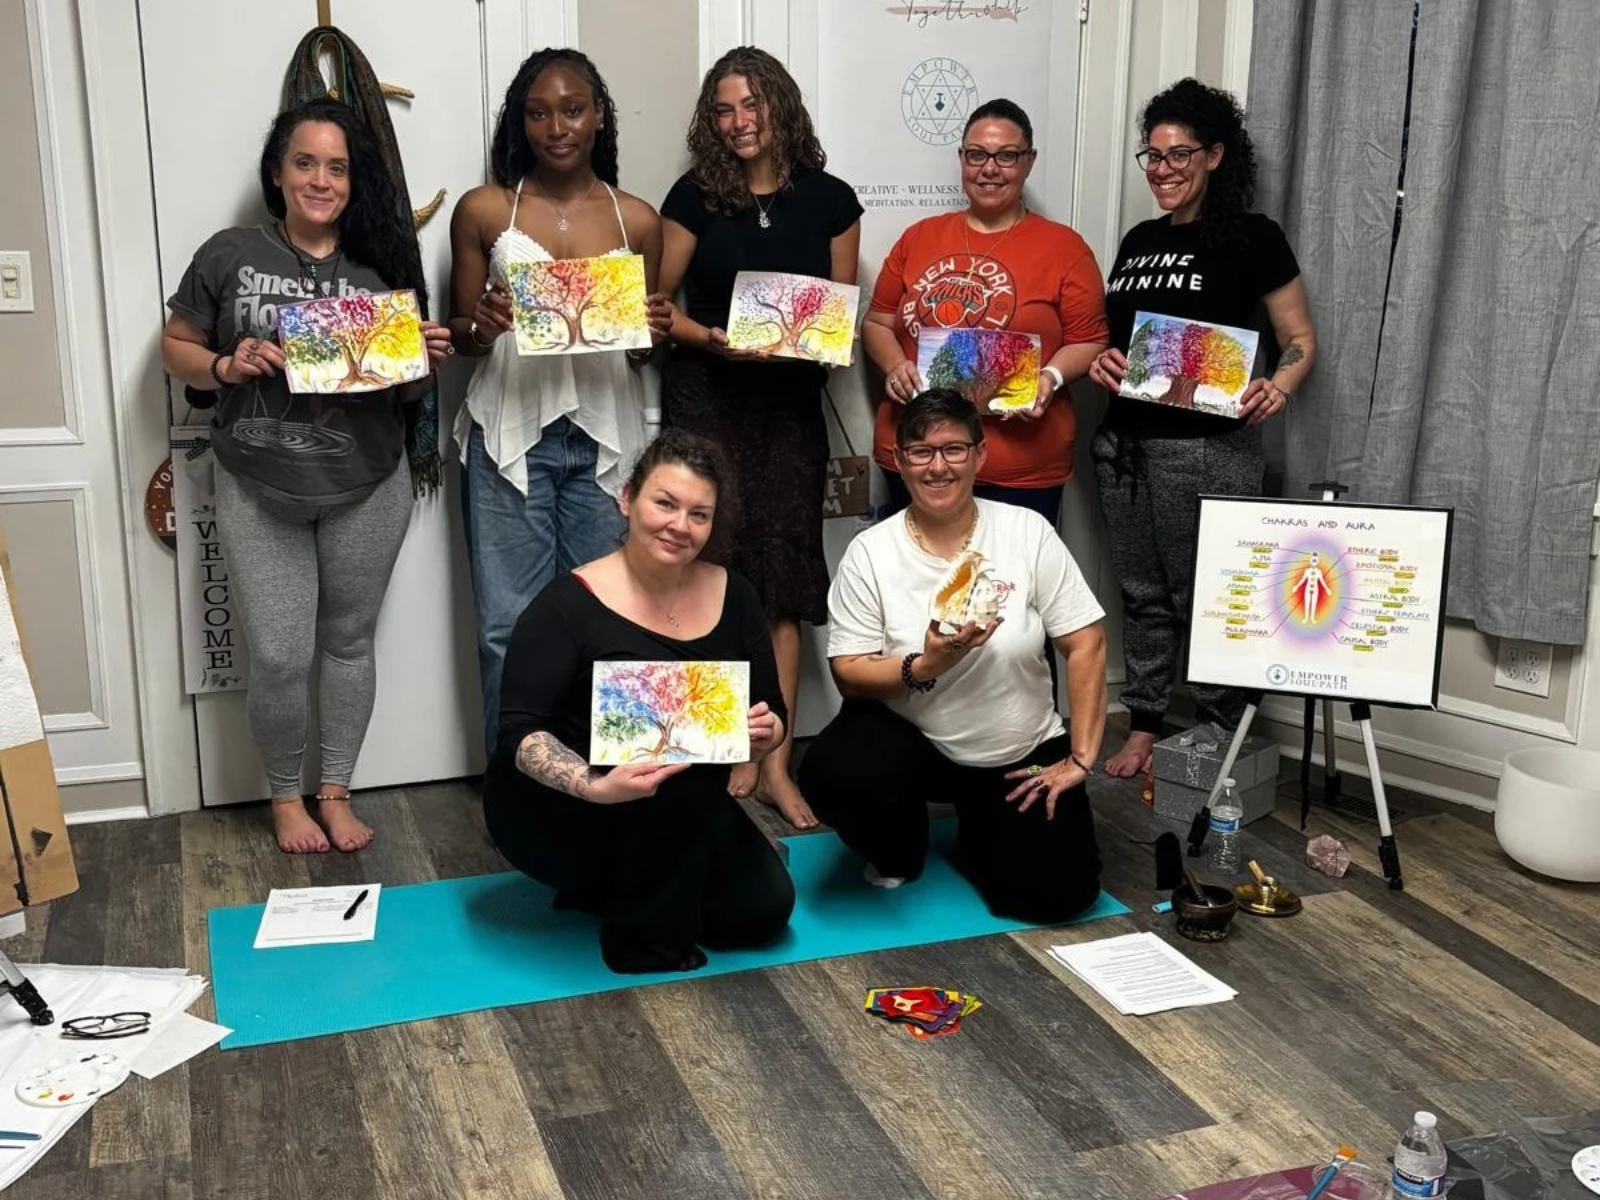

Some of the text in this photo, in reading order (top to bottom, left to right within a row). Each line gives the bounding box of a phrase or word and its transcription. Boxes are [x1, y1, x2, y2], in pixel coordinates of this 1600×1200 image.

[901, 58, 977, 97] EMPOWER
[853, 184, 959, 195] CREATIVE WELLNESS
[914, 256, 1013, 298] NEW YORK
[1107, 273, 1204, 294] MININE
[929, 280, 984, 303] KNICKS
[1261, 516, 1375, 531] CHAKRAS AND AURA
[192, 520, 235, 670] WELCOME
[1290, 670, 1348, 684] EMPOWER
